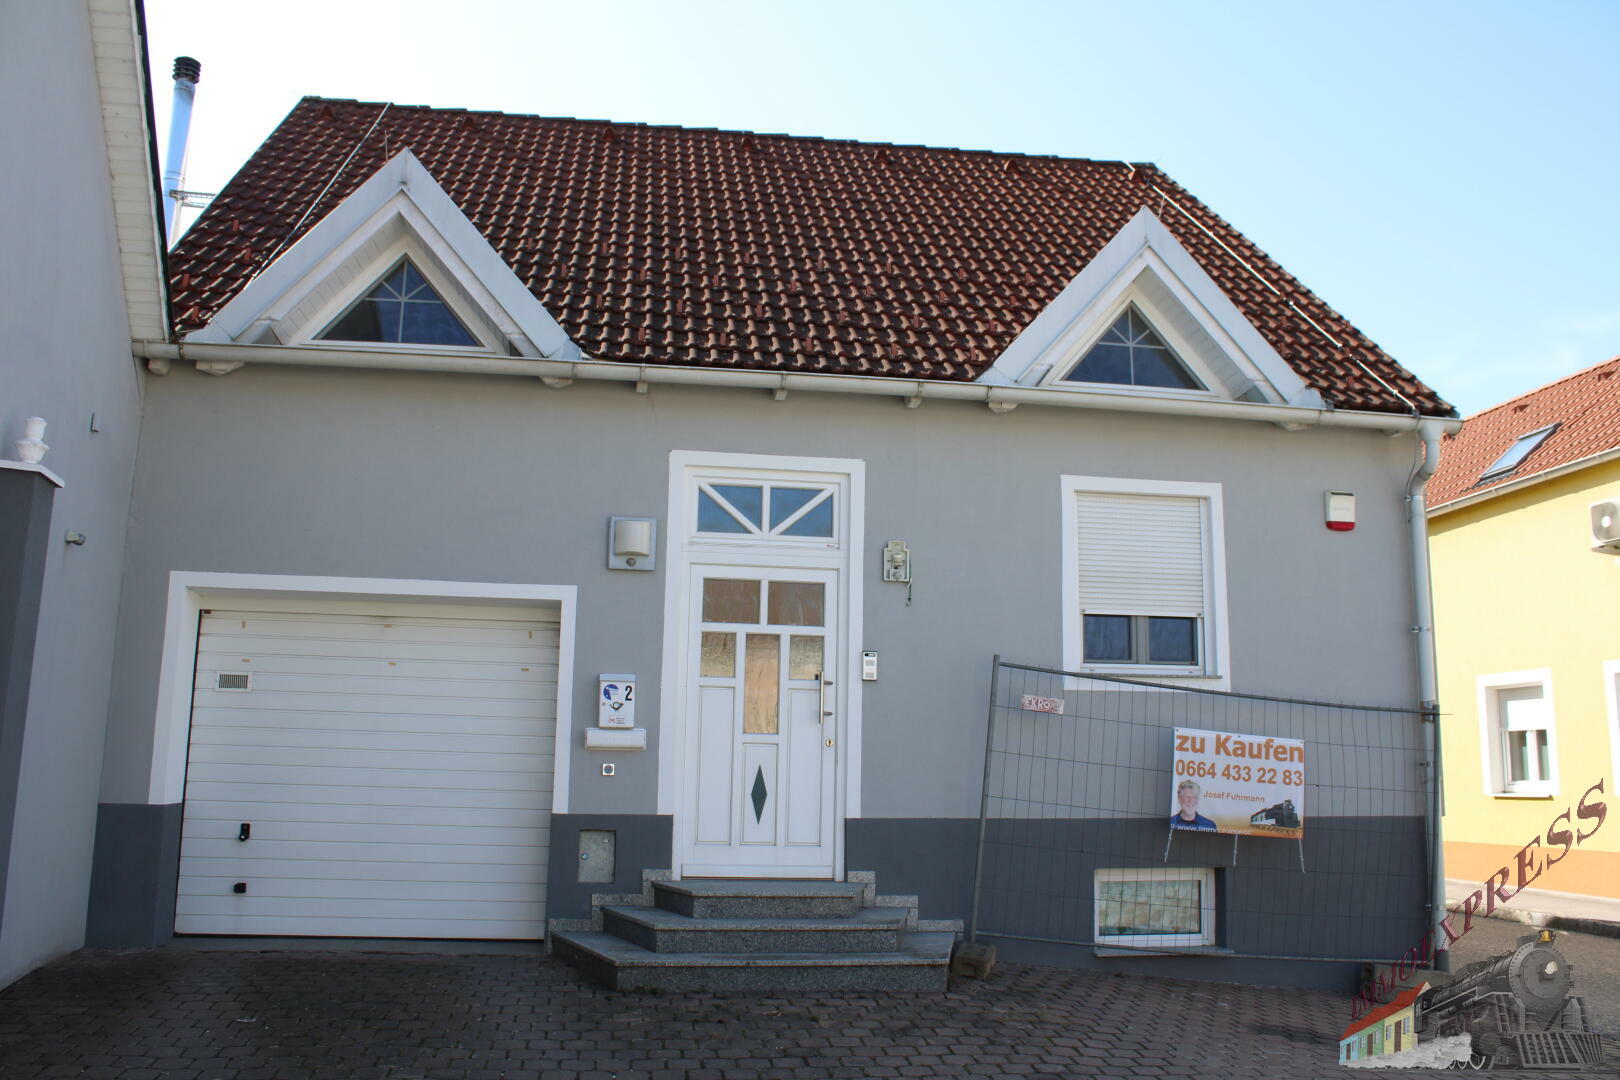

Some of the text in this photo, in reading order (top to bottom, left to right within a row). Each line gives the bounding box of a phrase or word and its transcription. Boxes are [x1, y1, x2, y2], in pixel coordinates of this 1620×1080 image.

[625, 685, 633, 701] 2
[1175, 733, 1304, 763] zu Kaufen
[1175, 759, 1303, 787] 0664 433 22 83
[1203, 791, 1225, 800] Josef
